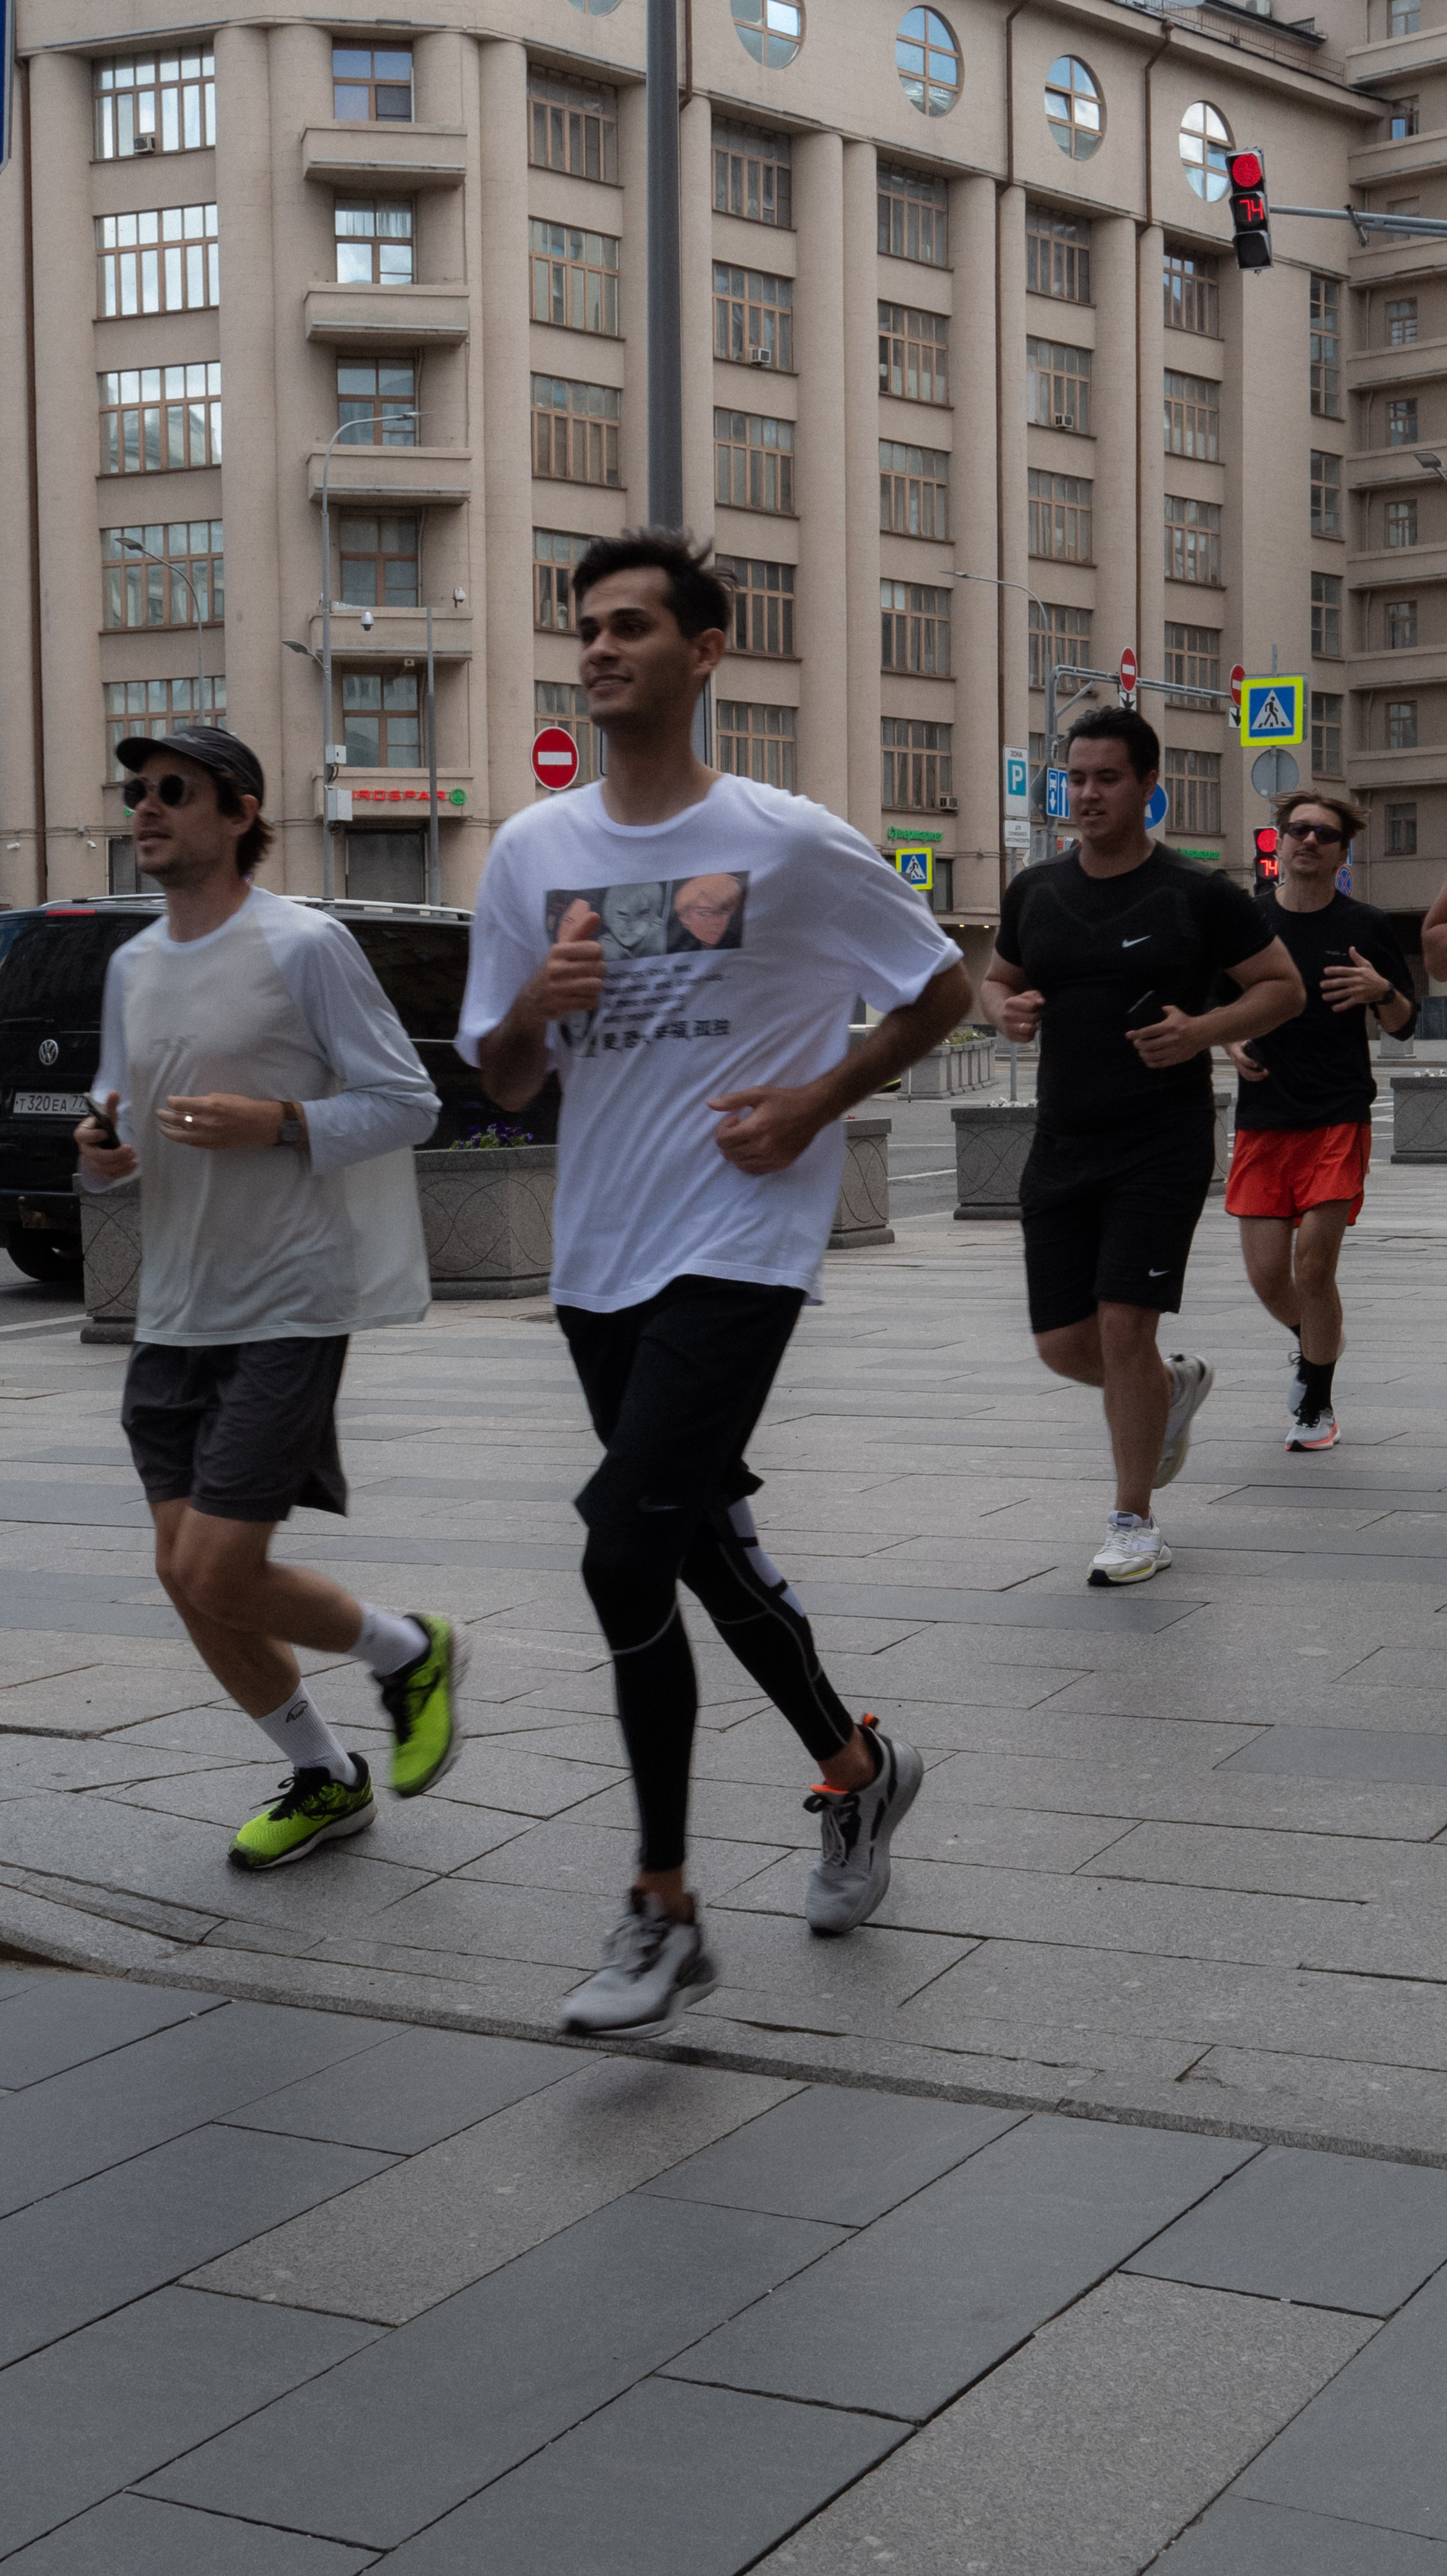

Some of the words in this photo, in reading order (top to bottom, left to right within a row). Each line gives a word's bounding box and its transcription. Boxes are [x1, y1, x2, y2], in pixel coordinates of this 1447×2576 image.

[1239, 198, 1264, 222] 74
[1010, 750, 1023, 758] ЗОНА
[1012, 765, 1023, 790] P
[351, 790, 446, 801] ROSPAR
[1260, 860, 1278, 877] 74
